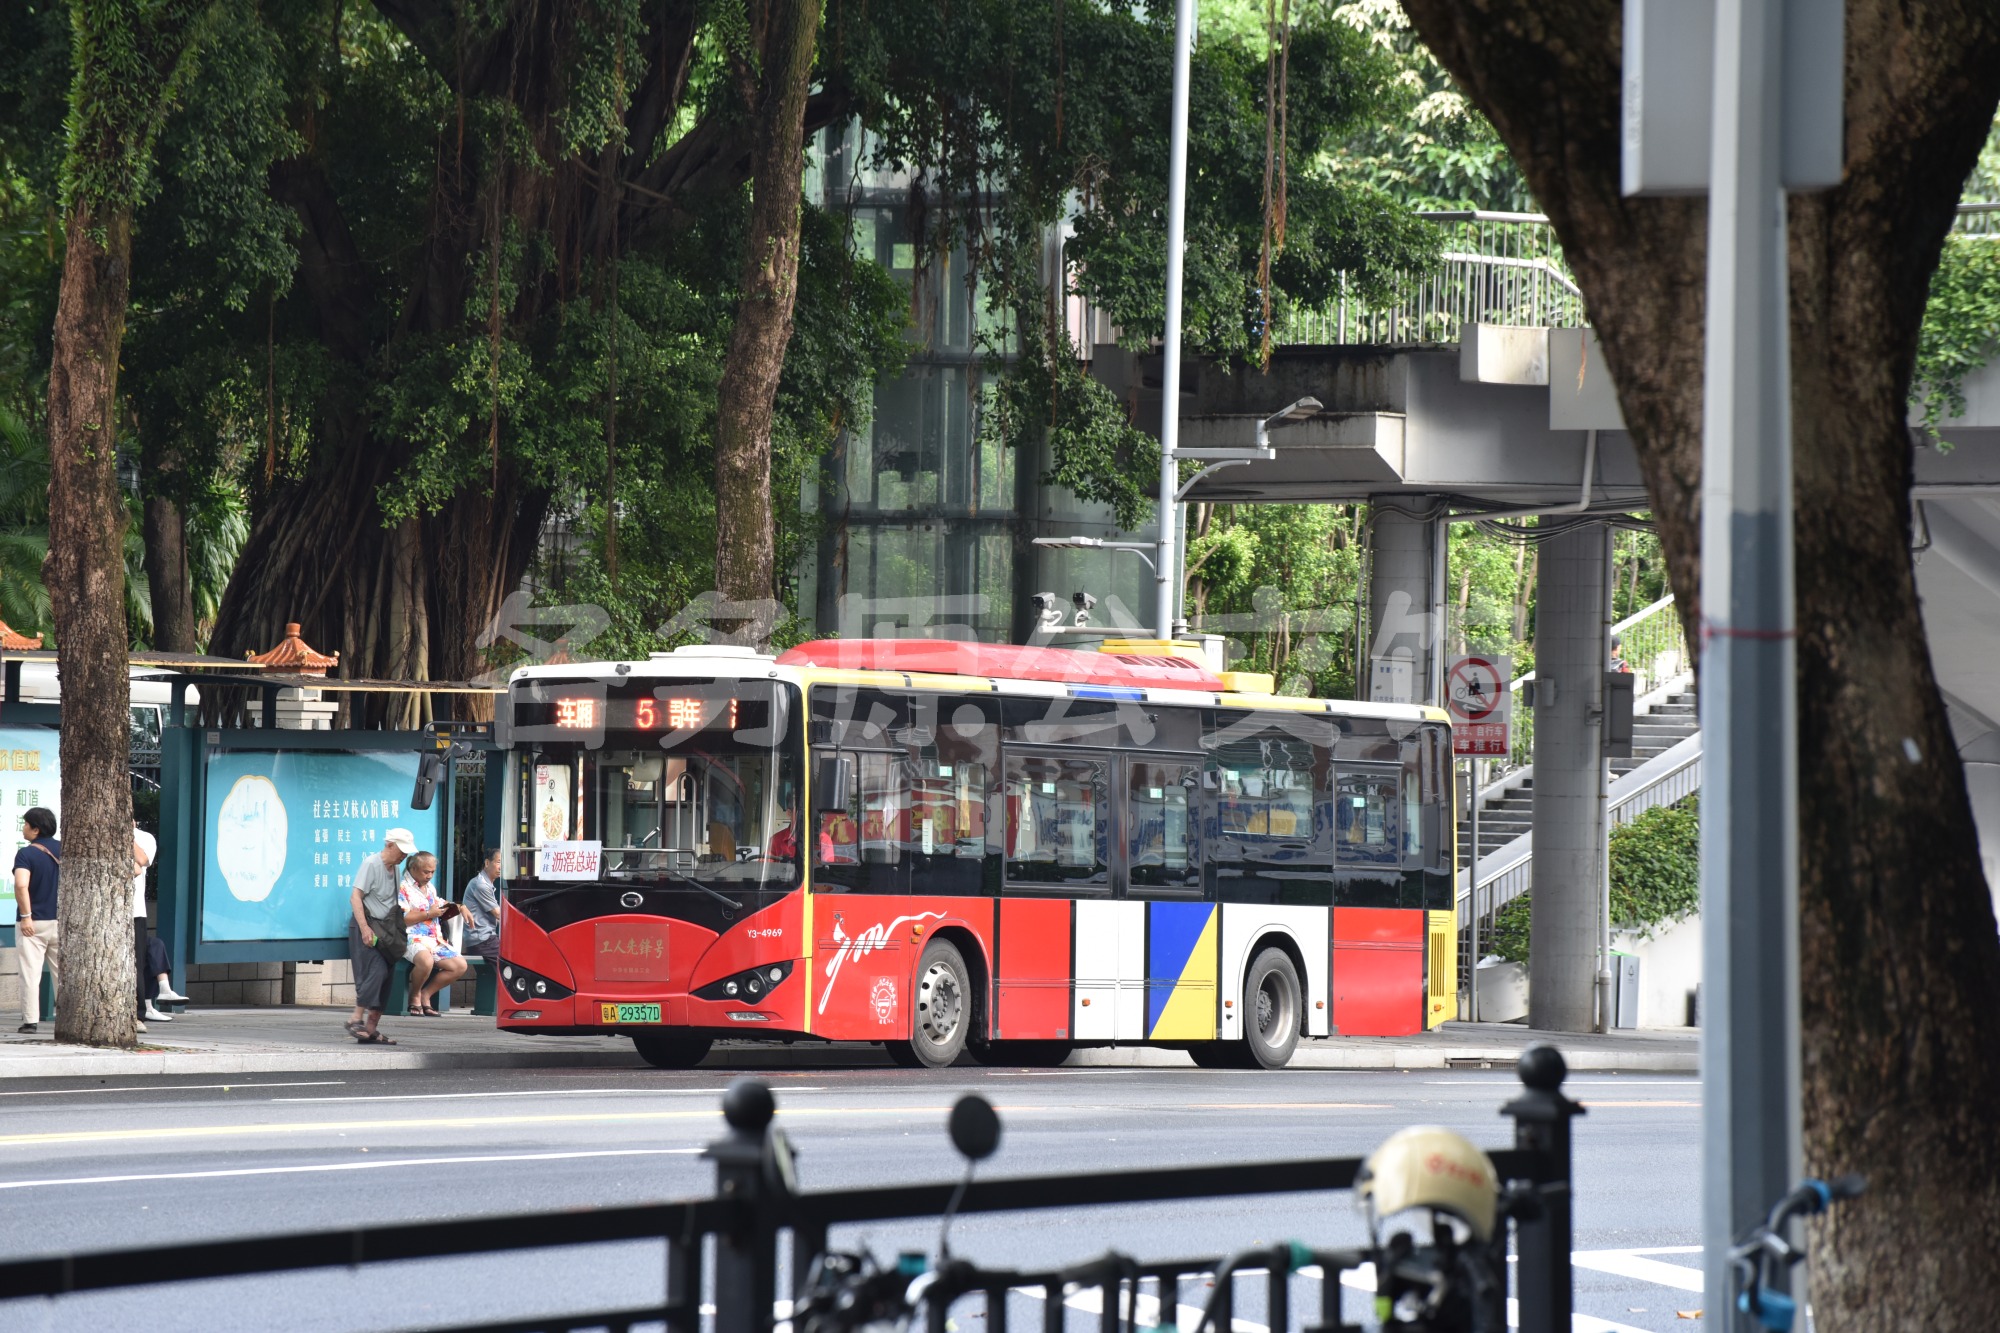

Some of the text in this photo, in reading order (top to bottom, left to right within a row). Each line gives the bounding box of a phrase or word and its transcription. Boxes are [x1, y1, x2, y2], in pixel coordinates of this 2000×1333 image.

[557, 697, 594, 728] 车厢
[637, 699, 655, 728] 5
[1452, 739, 1501, 752] 车推行
[17, 789, 39, 806] 和谐
[313, 800, 399, 818] 社会主义核心价值观
[314, 828, 329, 843] 富强
[337, 829, 351, 842] 民主
[361, 829, 376, 842] 文明
[314, 851, 329, 864] 自由
[338, 851, 351, 865] 平等
[552, 850, 598, 873] 沥滘总站
[314, 874, 351, 887] 爱国 敬业
[747, 928, 783, 939] Y3-4969
[600, 937, 664, 959] 工人先锋号
[603, 1006, 660, 1021] 粤A29357D
